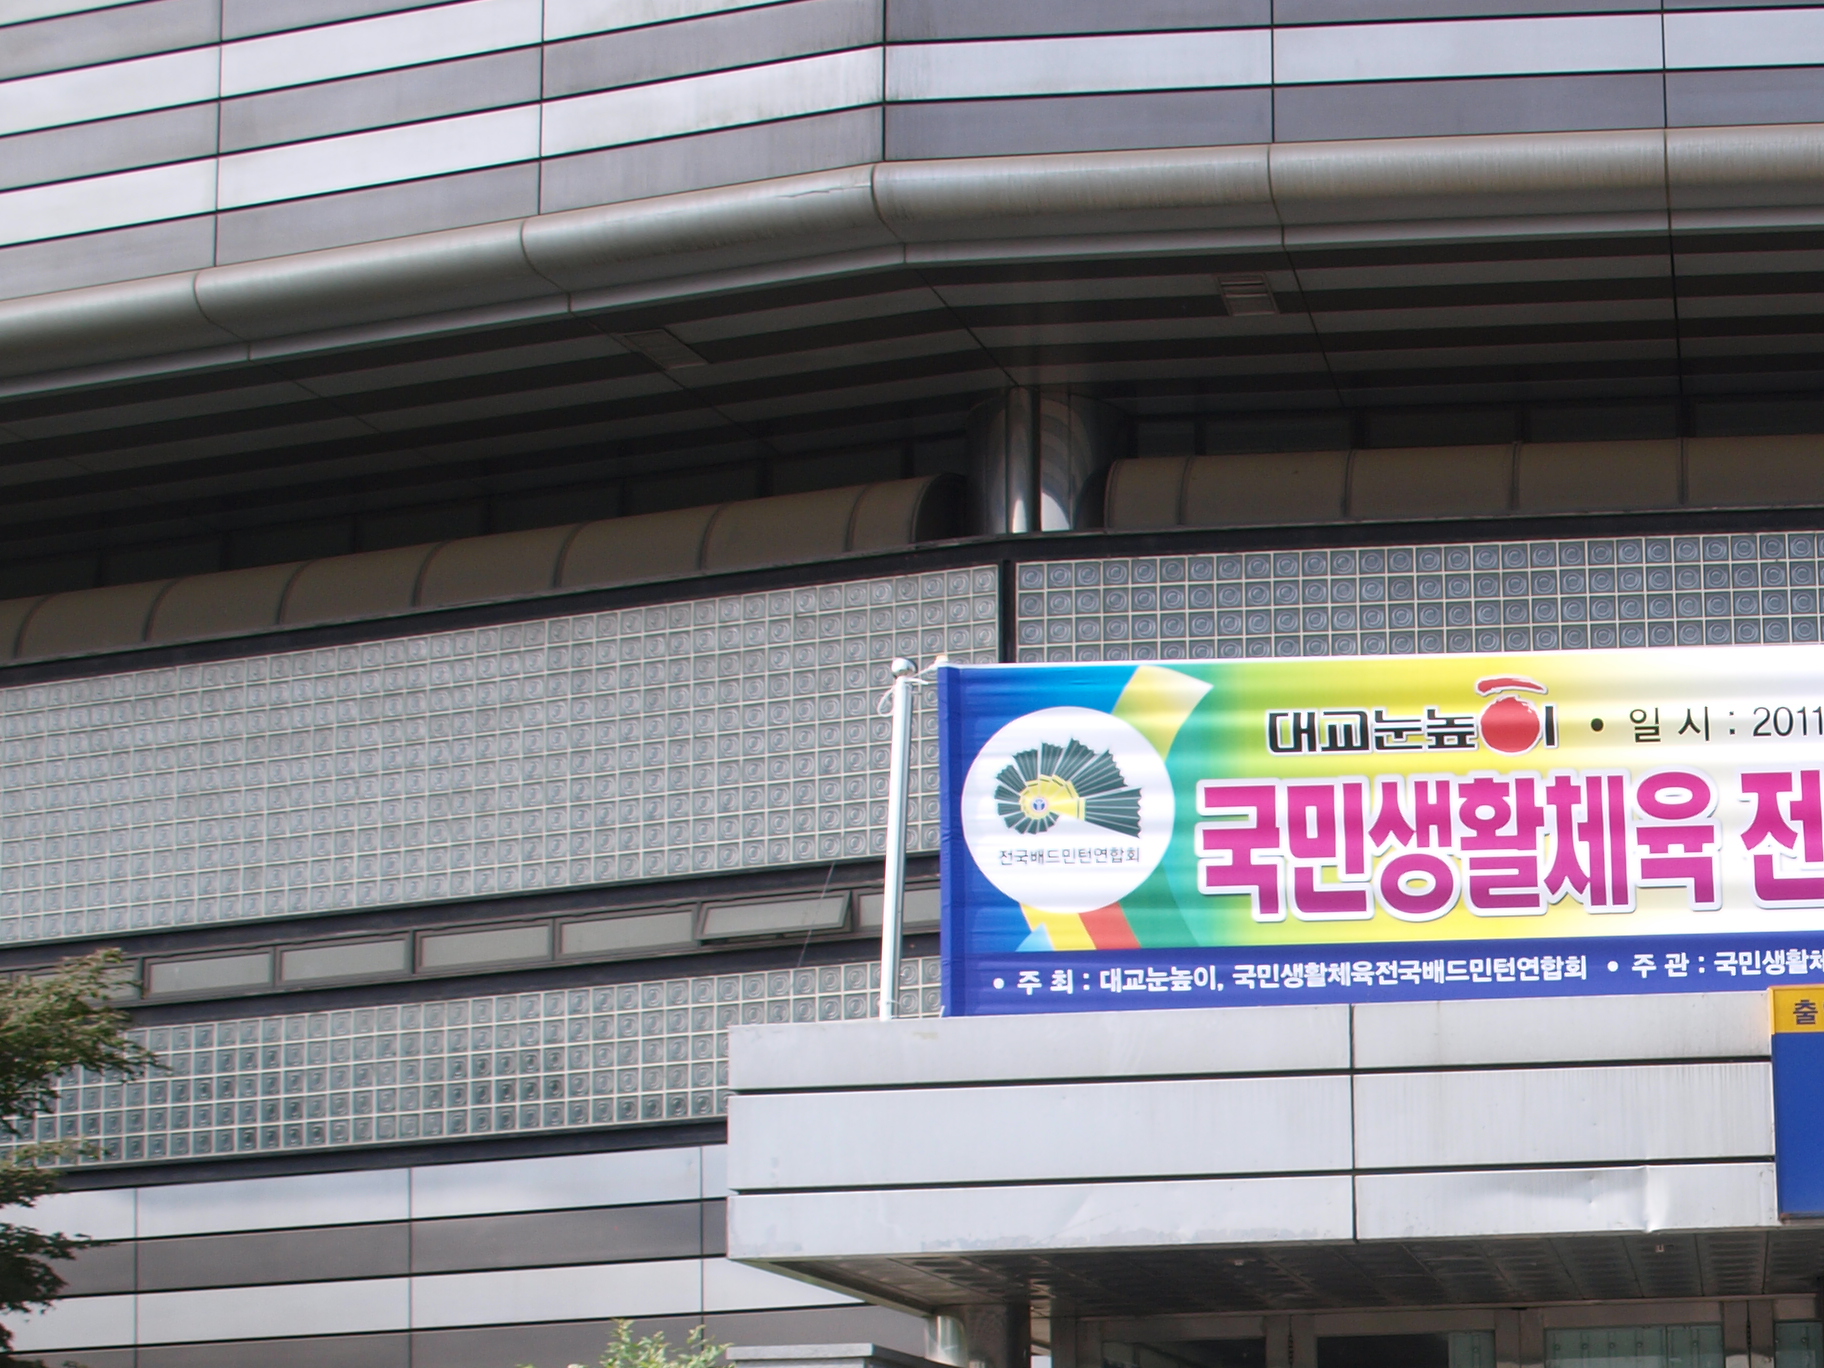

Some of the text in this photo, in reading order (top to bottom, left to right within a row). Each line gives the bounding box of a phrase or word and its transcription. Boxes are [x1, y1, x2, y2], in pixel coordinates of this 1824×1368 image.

[1268, 677, 1558, 754] 대교눈높이
[1000, 847, 1140, 867] 전국배드민턴연합회
[1200, 769, 1717, 915] 국민생활체육
[1099, 964, 1224, 993] 대교눈높이,
[1231, 955, 1588, 989] 국민생활체육전국배드민턴연합회
